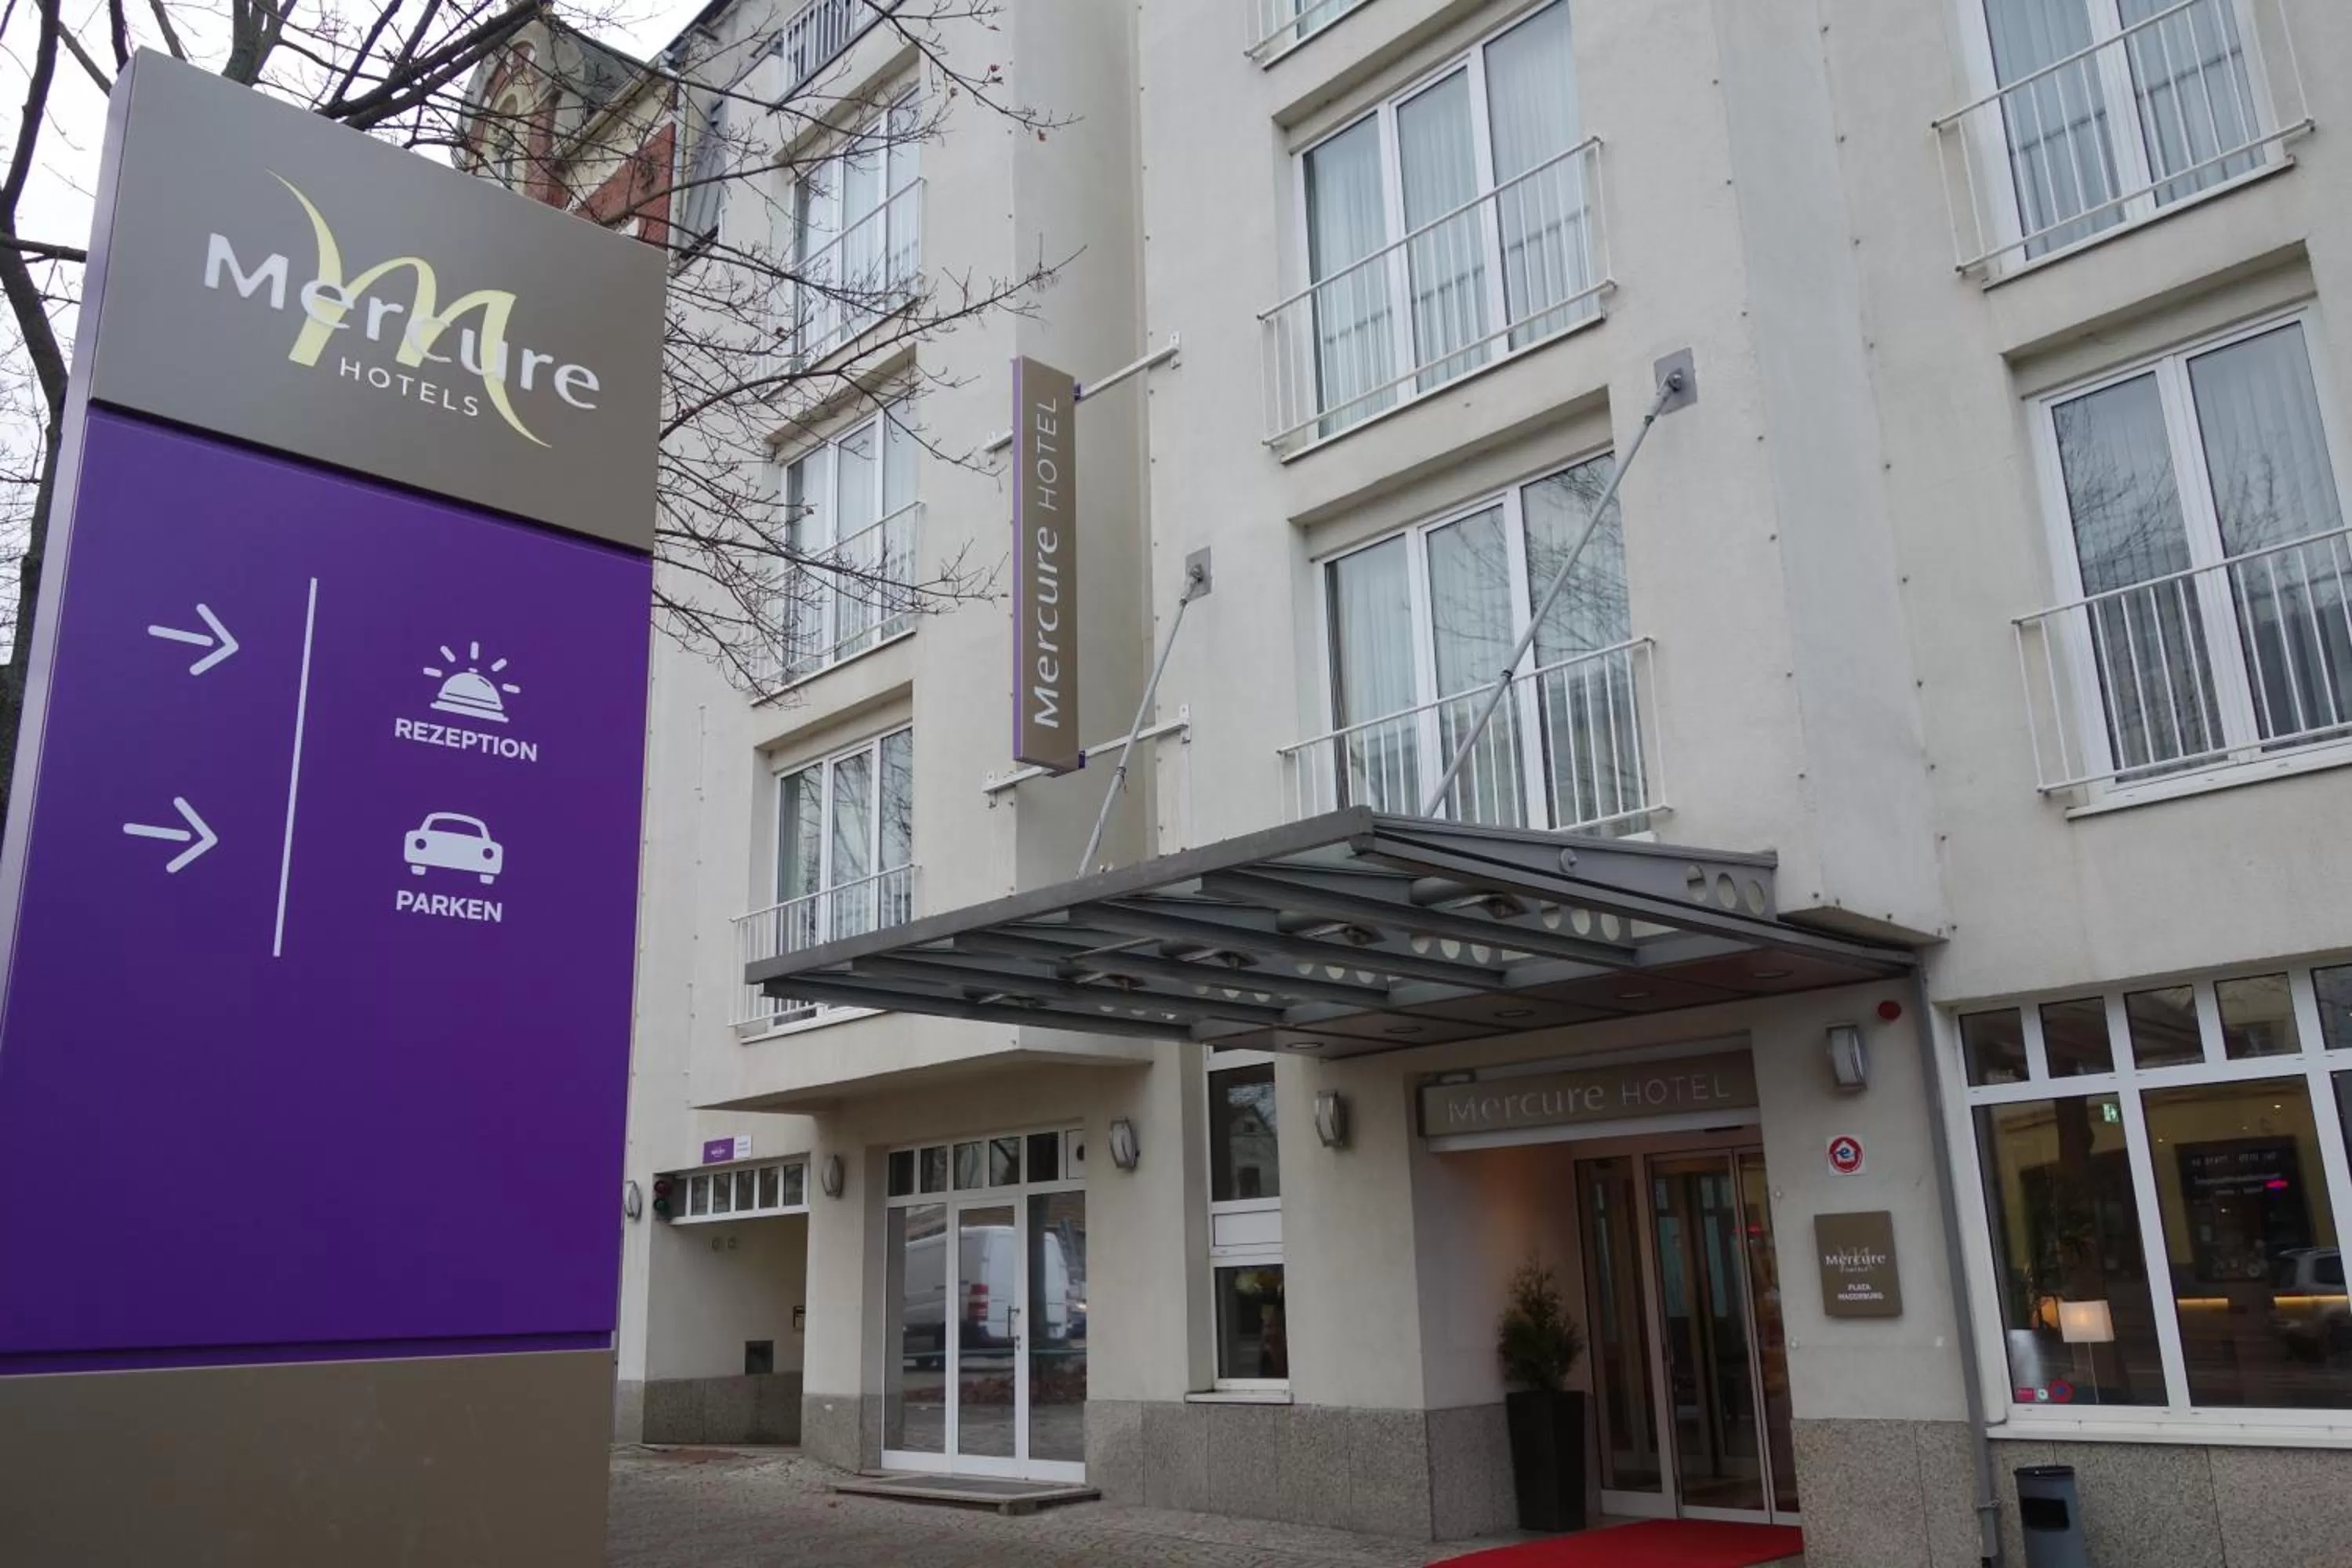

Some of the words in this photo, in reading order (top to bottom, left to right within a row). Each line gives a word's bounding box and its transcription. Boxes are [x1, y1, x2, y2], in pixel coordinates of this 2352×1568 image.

[203, 232, 601, 410] Mercure
[339, 356, 479, 417] HOTELS
[1036, 397, 1058, 512] HOTEL
[1033, 526, 1060, 729] Mercure
[394, 718, 537, 763] REZEPTION
[395, 890, 503, 923] PARKEN
[1446, 1083, 1606, 1125] Mercure
[1620, 1072, 1732, 1105] HOTEL
